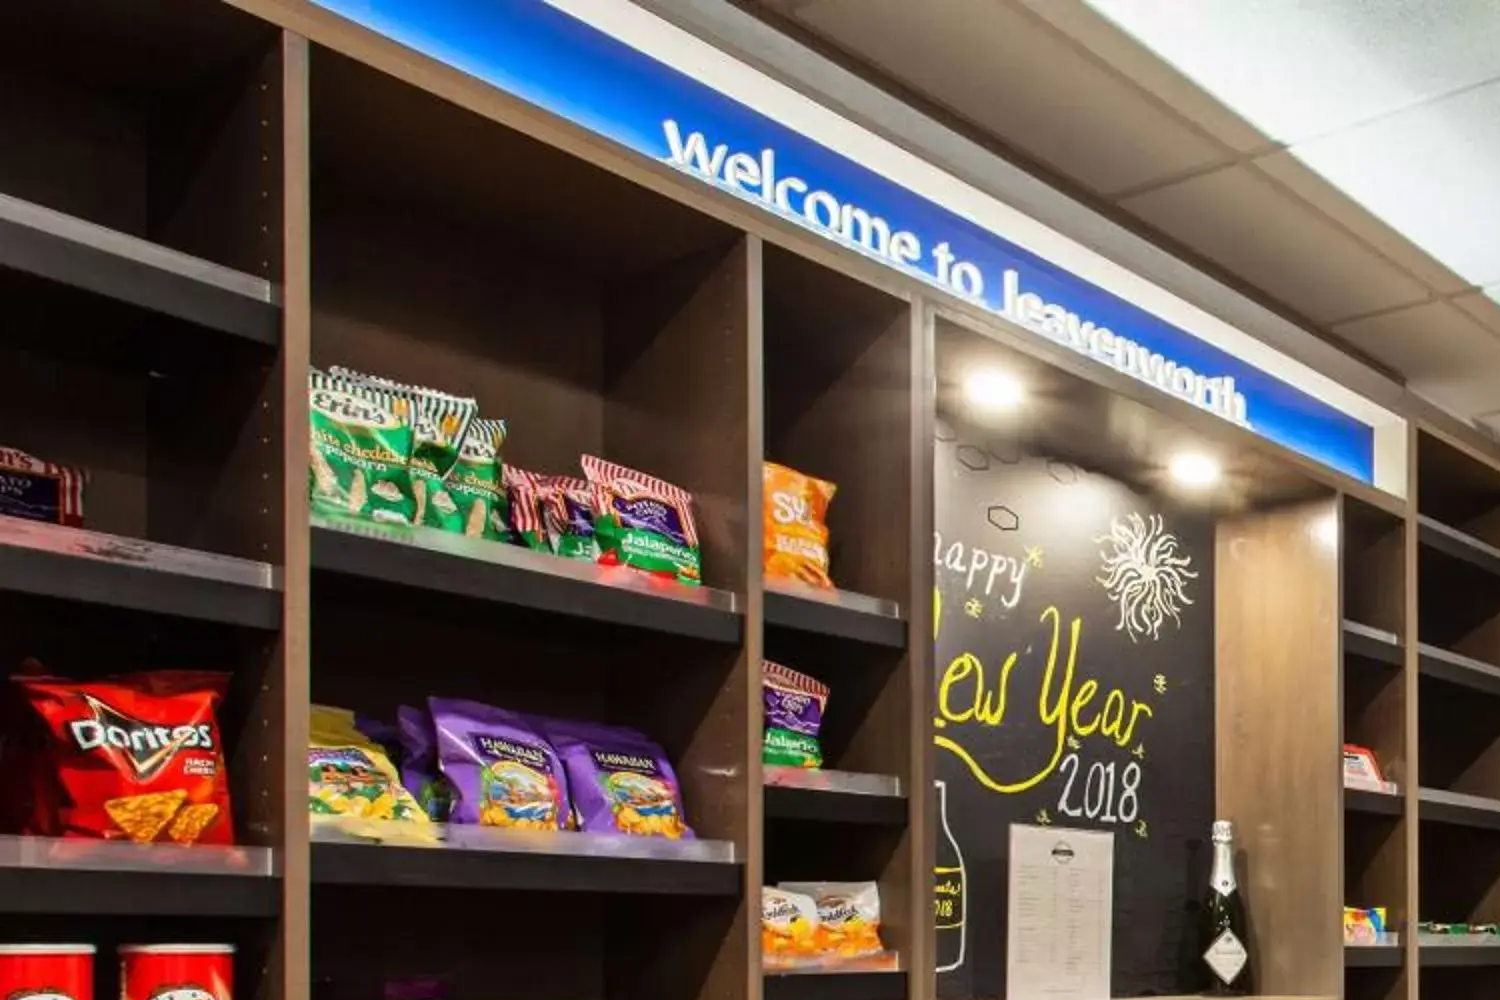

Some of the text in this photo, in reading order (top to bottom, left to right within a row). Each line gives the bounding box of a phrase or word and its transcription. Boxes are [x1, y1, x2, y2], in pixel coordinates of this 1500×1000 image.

[932, 241, 987, 299] to
[70, 719, 213, 751] Doritos
[1058, 753, 1142, 823] 2018
